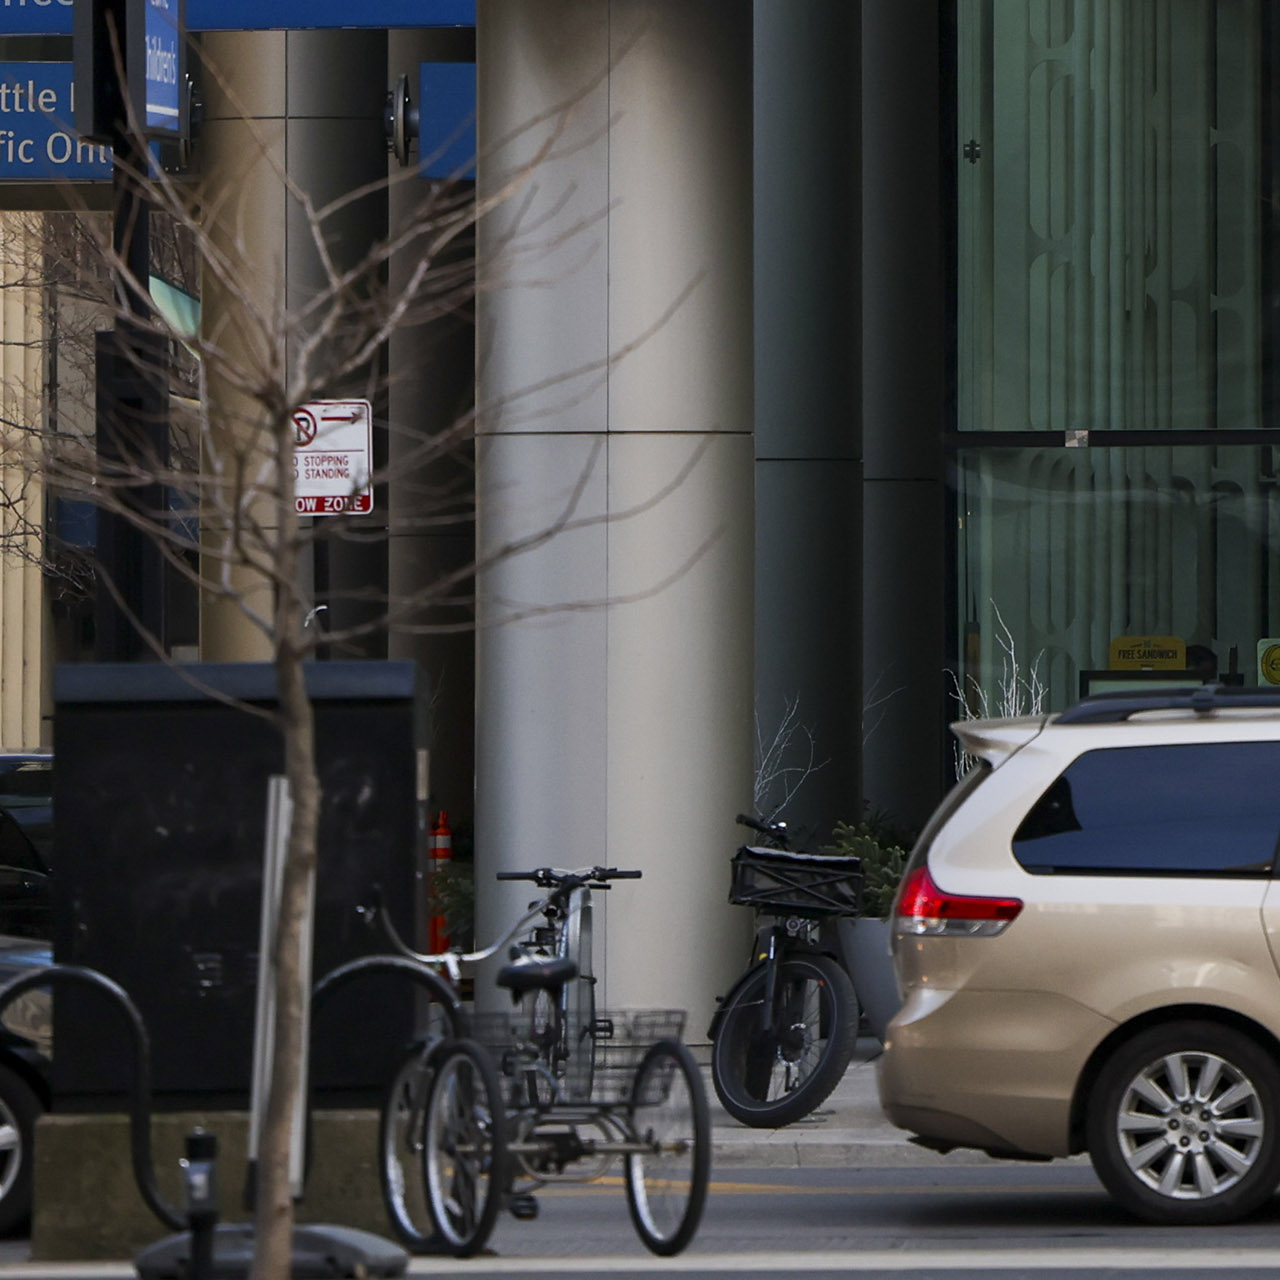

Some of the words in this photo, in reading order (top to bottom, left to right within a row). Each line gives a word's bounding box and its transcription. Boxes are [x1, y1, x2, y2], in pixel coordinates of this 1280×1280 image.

[146, 35, 176, 85] hildren's
[46, 131, 113, 172] Onl
[304, 456, 349, 466] STOPPING
[305, 468, 350, 479] STANDING
